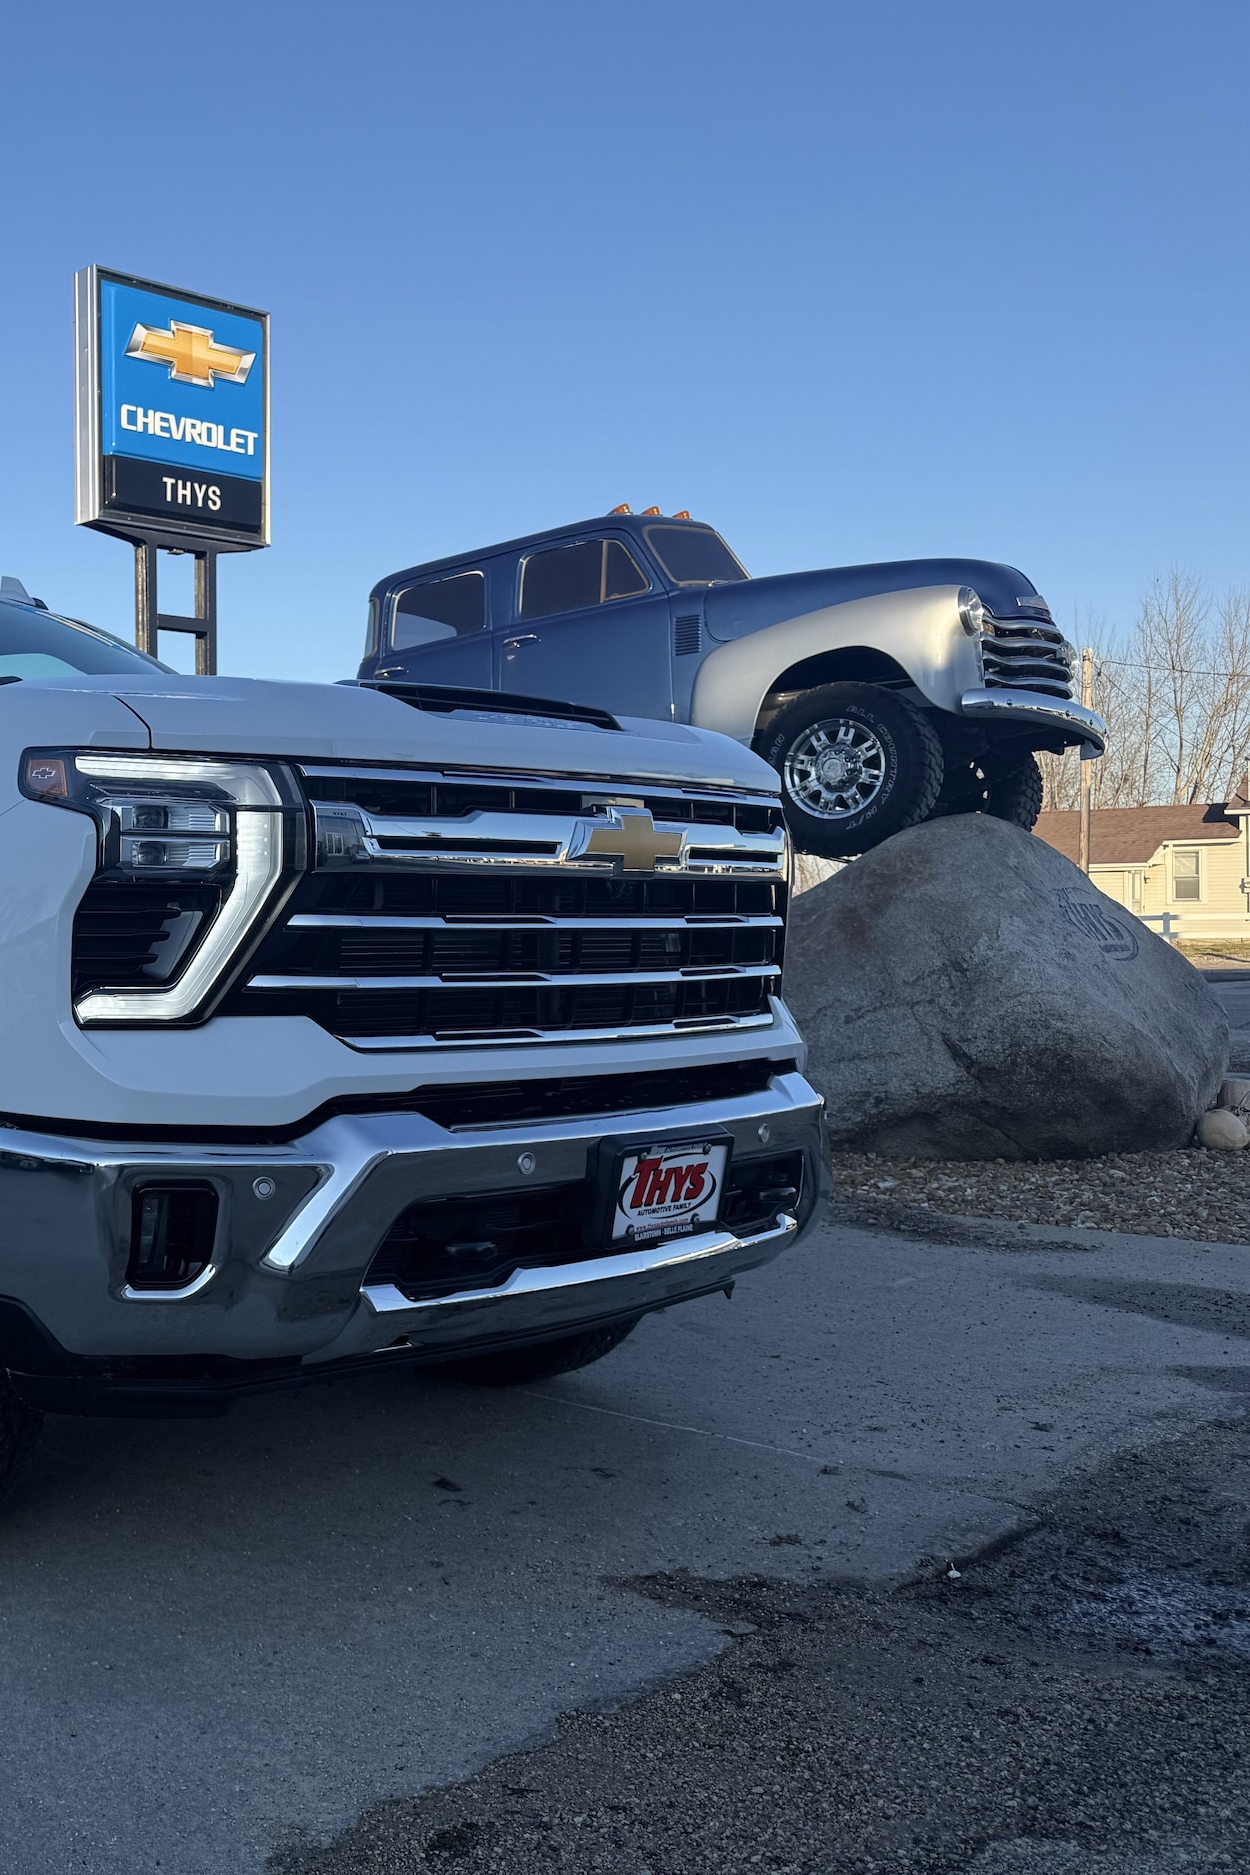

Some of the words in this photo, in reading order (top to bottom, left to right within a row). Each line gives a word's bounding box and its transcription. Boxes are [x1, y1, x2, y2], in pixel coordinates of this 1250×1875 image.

[120, 403, 259, 456] CHEVROLET
[162, 476, 222, 511] THYS
[629, 1155, 709, 1210] THYS
[636, 1205, 672, 1217] AUTOMOTIVE
[672, 1202, 692, 1212] FAMILY
